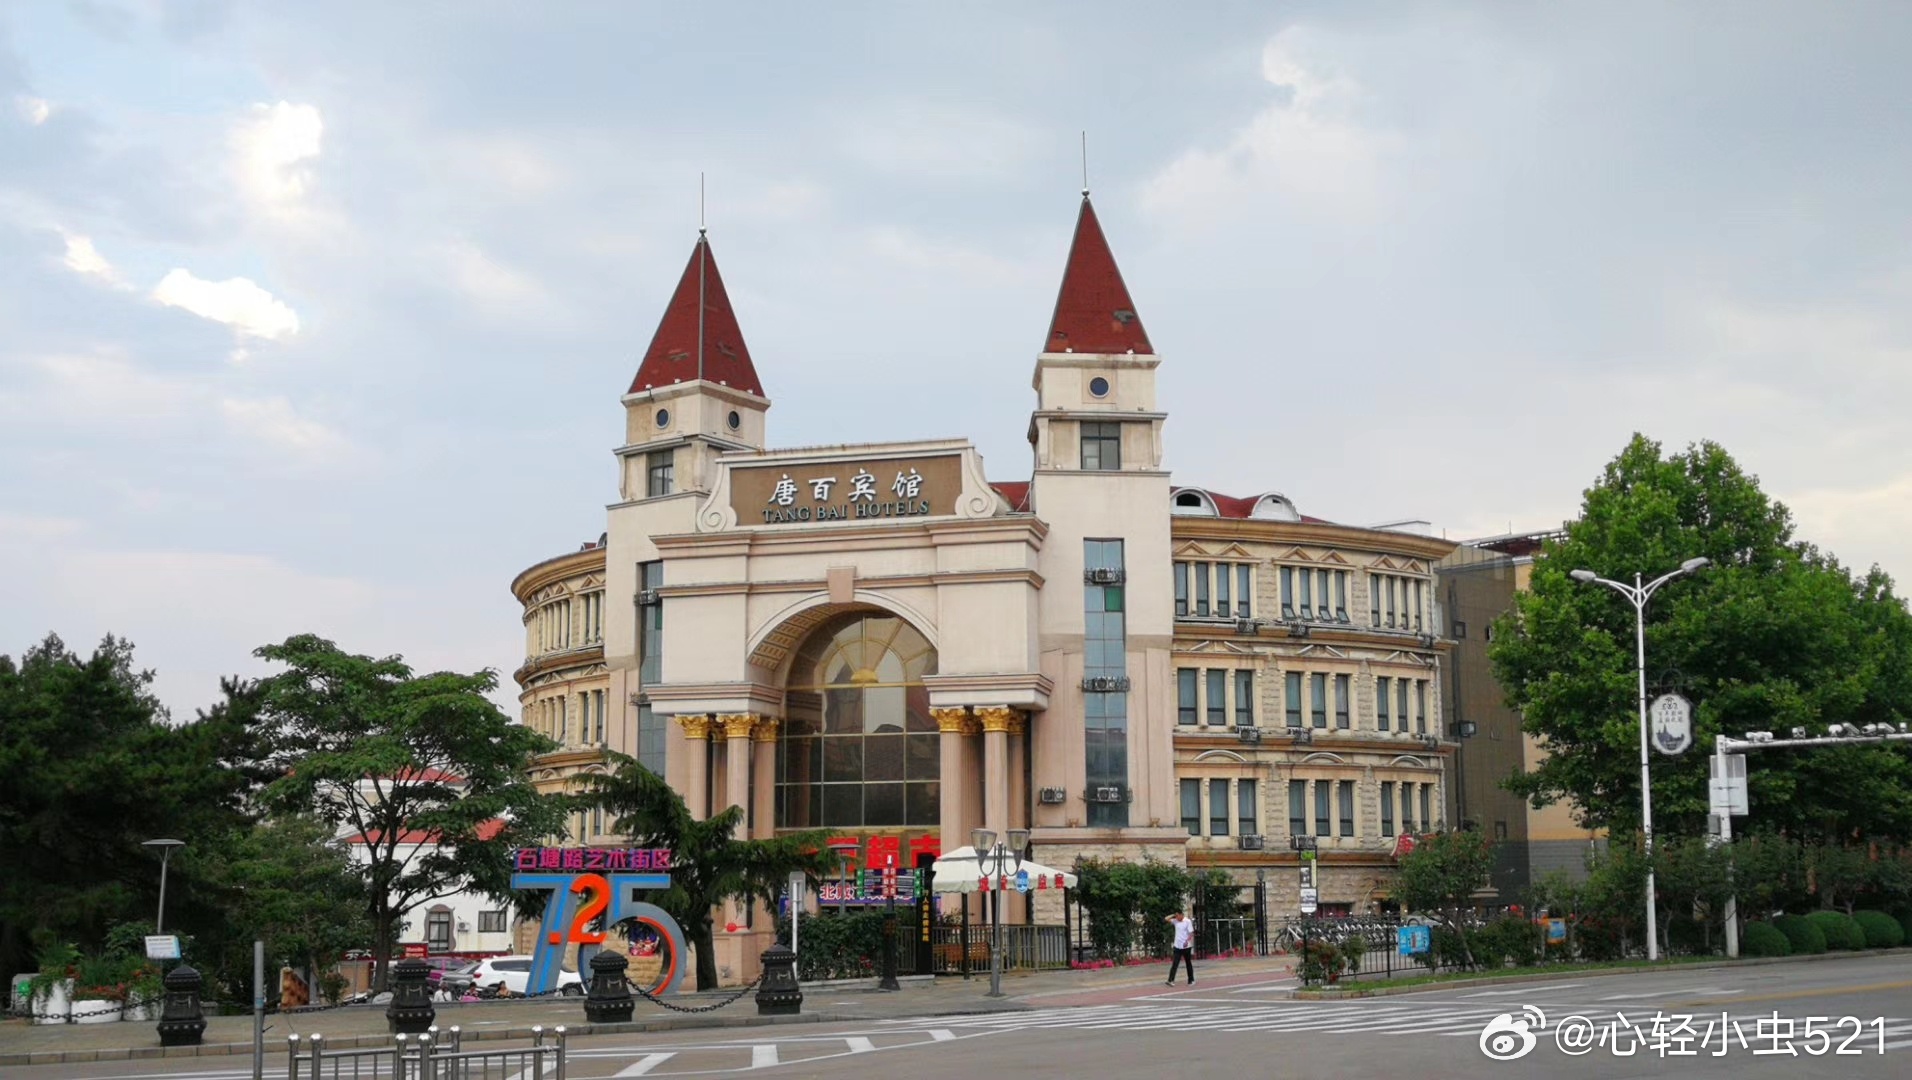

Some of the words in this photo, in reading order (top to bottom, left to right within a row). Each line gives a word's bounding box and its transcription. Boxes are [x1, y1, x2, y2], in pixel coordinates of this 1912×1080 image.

[768, 467, 923, 506] 唐百宾馆
[762, 507, 811, 523] TANG
[816, 505, 847, 521] BAI
[856, 500, 930, 517] HOTELS
[516, 848, 672, 870] 石塘路艺术街区
